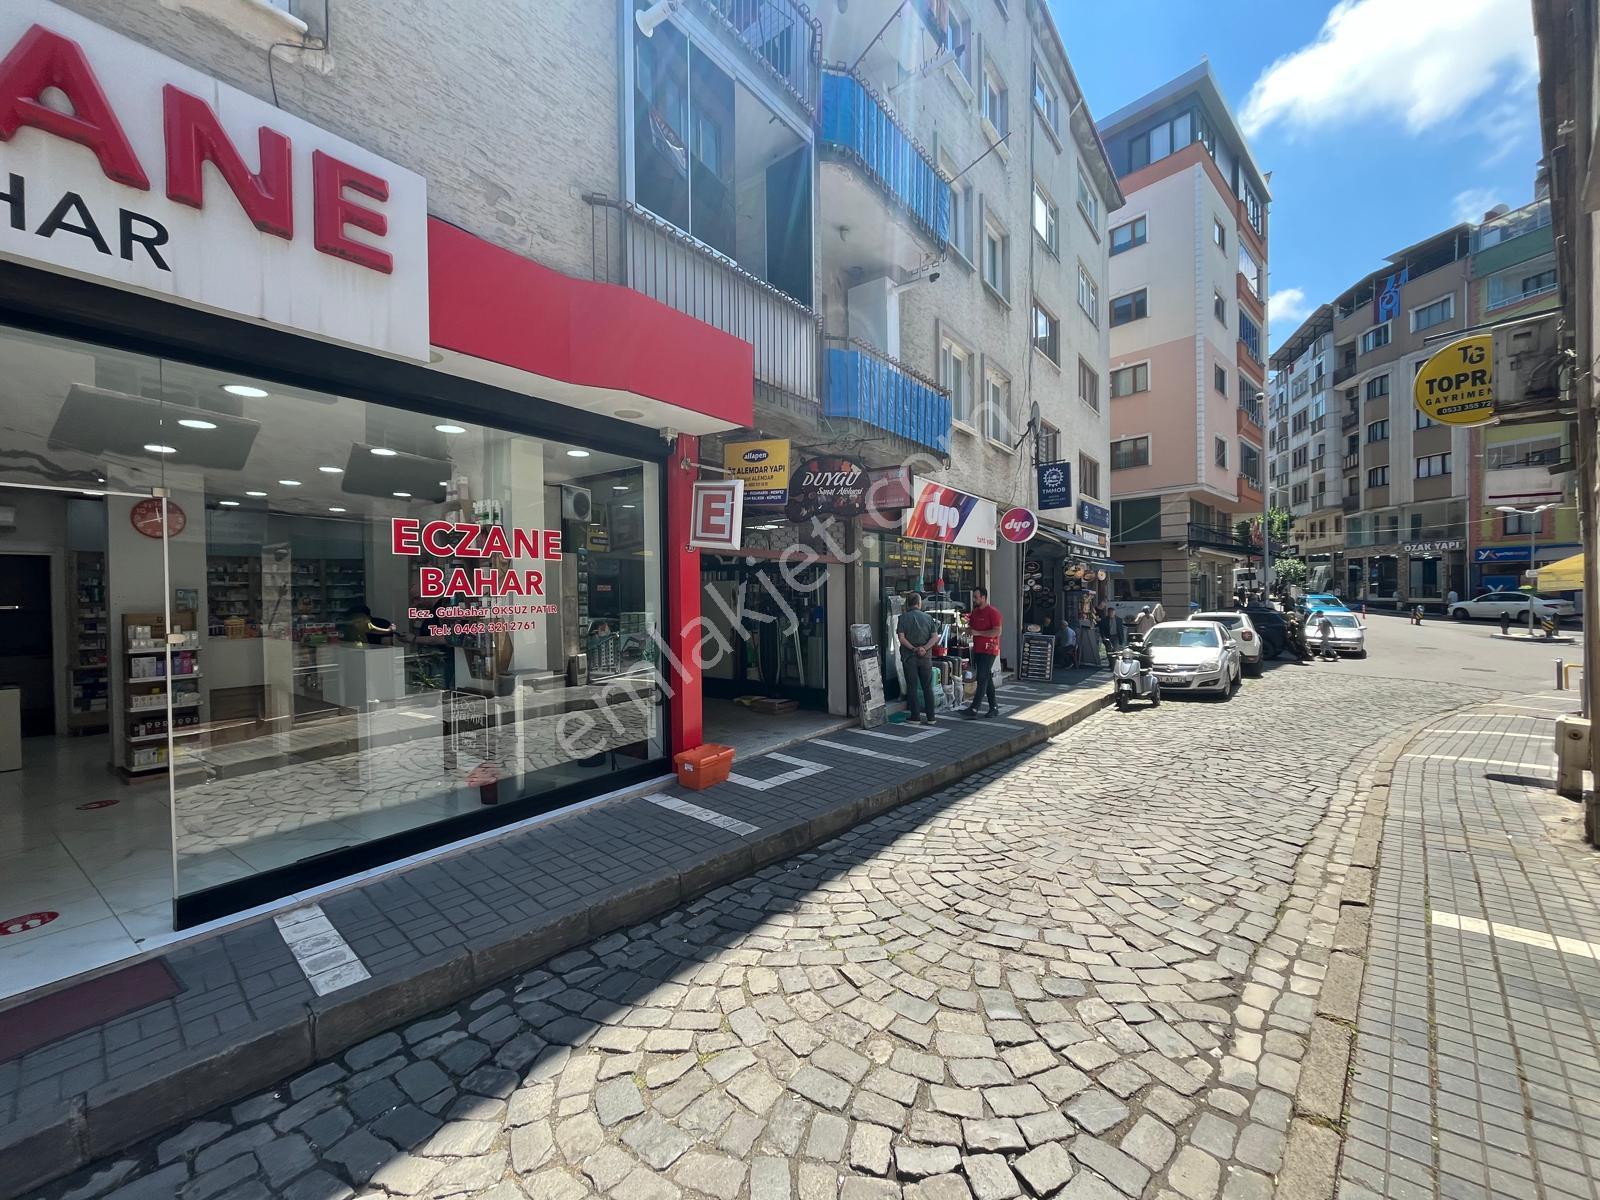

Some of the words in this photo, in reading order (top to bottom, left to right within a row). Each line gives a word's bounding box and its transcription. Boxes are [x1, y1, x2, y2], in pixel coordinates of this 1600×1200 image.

[1457, 344, 1486, 365] TG
[744, 452, 767, 460] alfapen
[737, 465, 768, 475] ALEMDAR
[770, 464, 785, 473] YAPI
[802, 471, 862, 486] DUYGU
[817, 486, 837, 496] Sanat
[1042, 487, 1066, 495] TMMOB
[701, 493, 727, 535] E
[924, 491, 960, 538] dyo
[1004, 519, 1031, 532] dyo
[391, 517, 563, 561] ECZANE
[1434, 541, 1460, 550] YAPI
[419, 567, 545, 598] BAHAR
[408, 607, 434, 619] Ecz.
[436, 605, 489, 618] Gülbahar
[491, 604, 528, 615] ÖKSÜZ
[530, 603, 558, 614] PATIR
[453, 623, 486, 635] 0462
[488, 621, 537, 634] 3212761
